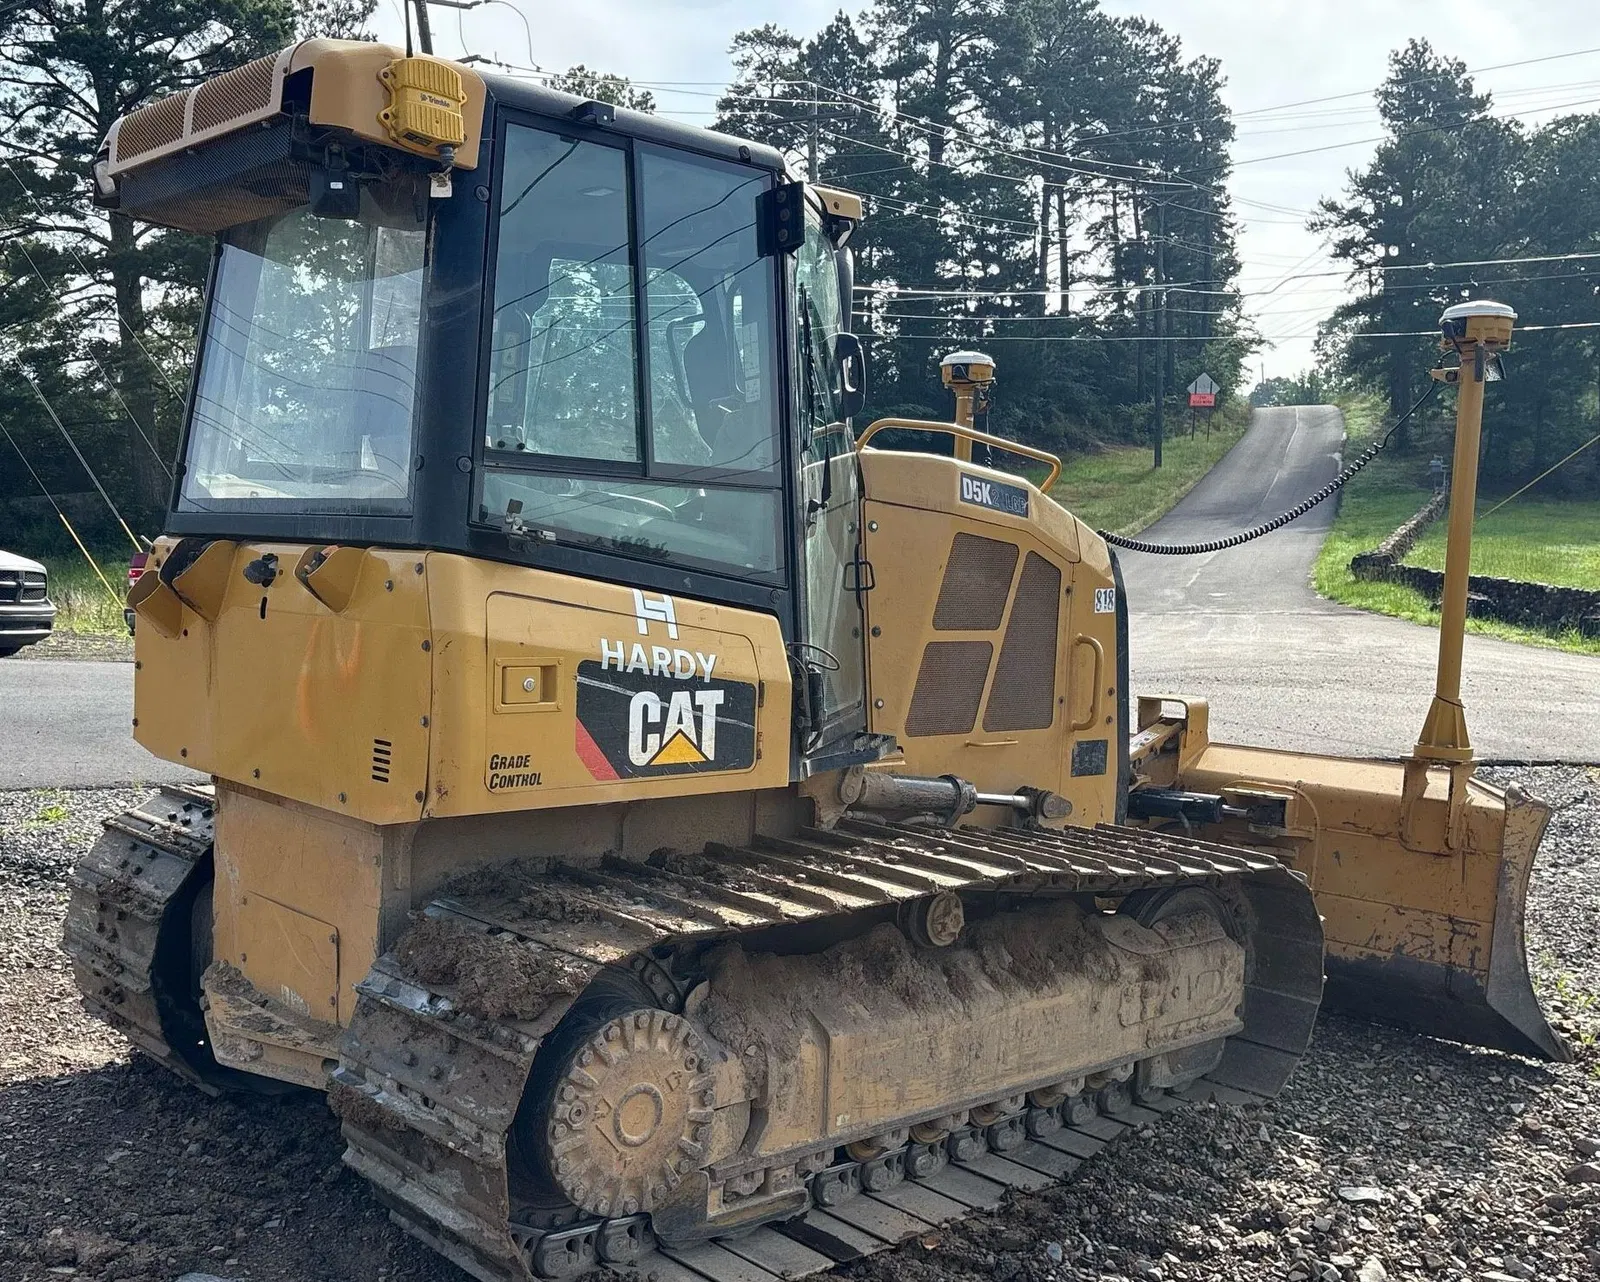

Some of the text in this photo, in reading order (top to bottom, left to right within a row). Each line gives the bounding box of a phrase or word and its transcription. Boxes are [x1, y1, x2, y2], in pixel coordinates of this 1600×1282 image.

[427, 96, 450, 108] Trimble
[600, 638, 718, 683] HARDY
[628, 689, 724, 767] CAT
[489, 754, 531, 771] GRADE
[489, 772, 543, 790] CONTROL
